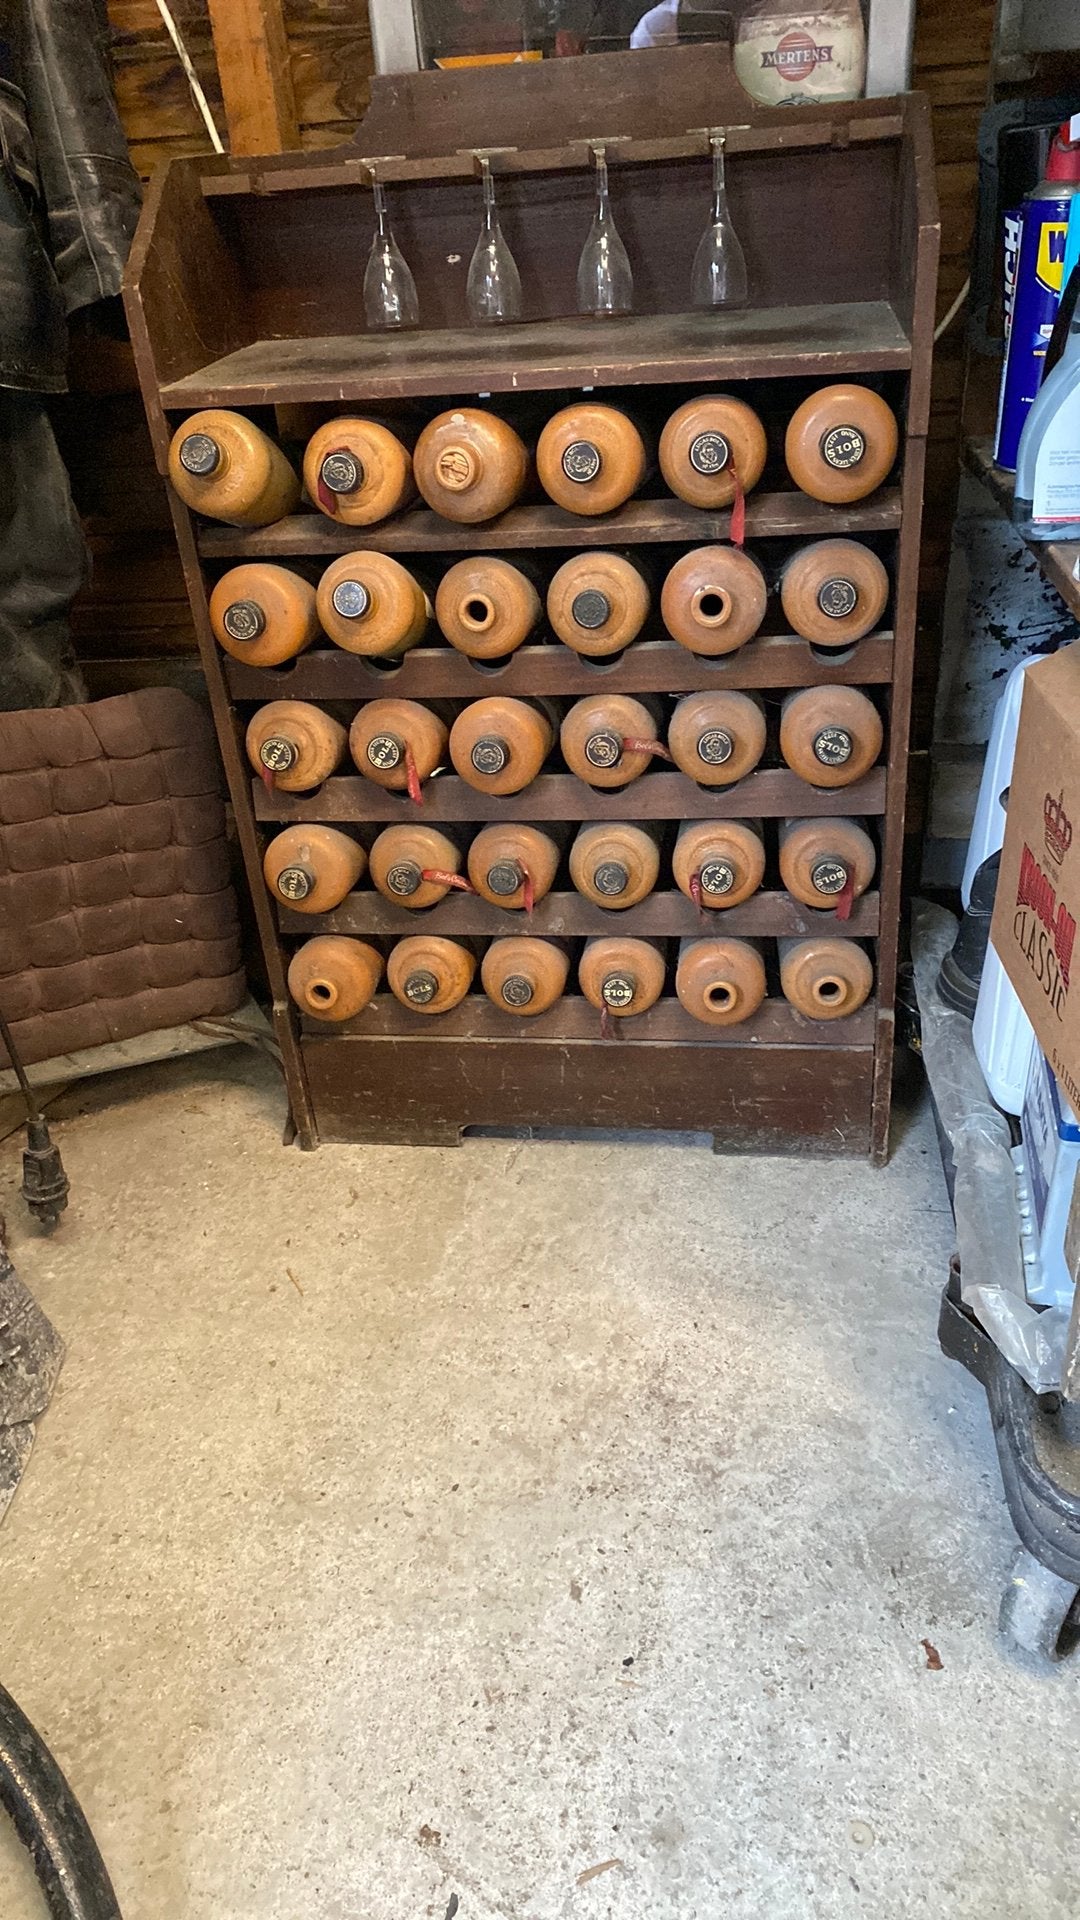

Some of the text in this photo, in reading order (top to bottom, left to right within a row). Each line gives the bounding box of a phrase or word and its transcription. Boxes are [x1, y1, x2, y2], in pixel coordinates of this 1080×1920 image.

[764, 48, 829, 66] MERTENS
[695, 437, 722, 452] LUCAS BOLS
[827, 438, 860, 458] BOLS
[267, 742, 284, 767] BOLS
[374, 740, 392, 765] BOLS
[818, 739, 849, 757] BOLS
[288, 872, 298, 897] BOLS
[708, 867, 727, 891] BOLS
[816, 871, 844, 887] BOLS
[1013, 911, 1066, 1022] CLASSIC
[407, 985, 431, 997] BOLS
[604, 989, 630, 997] BOLS
